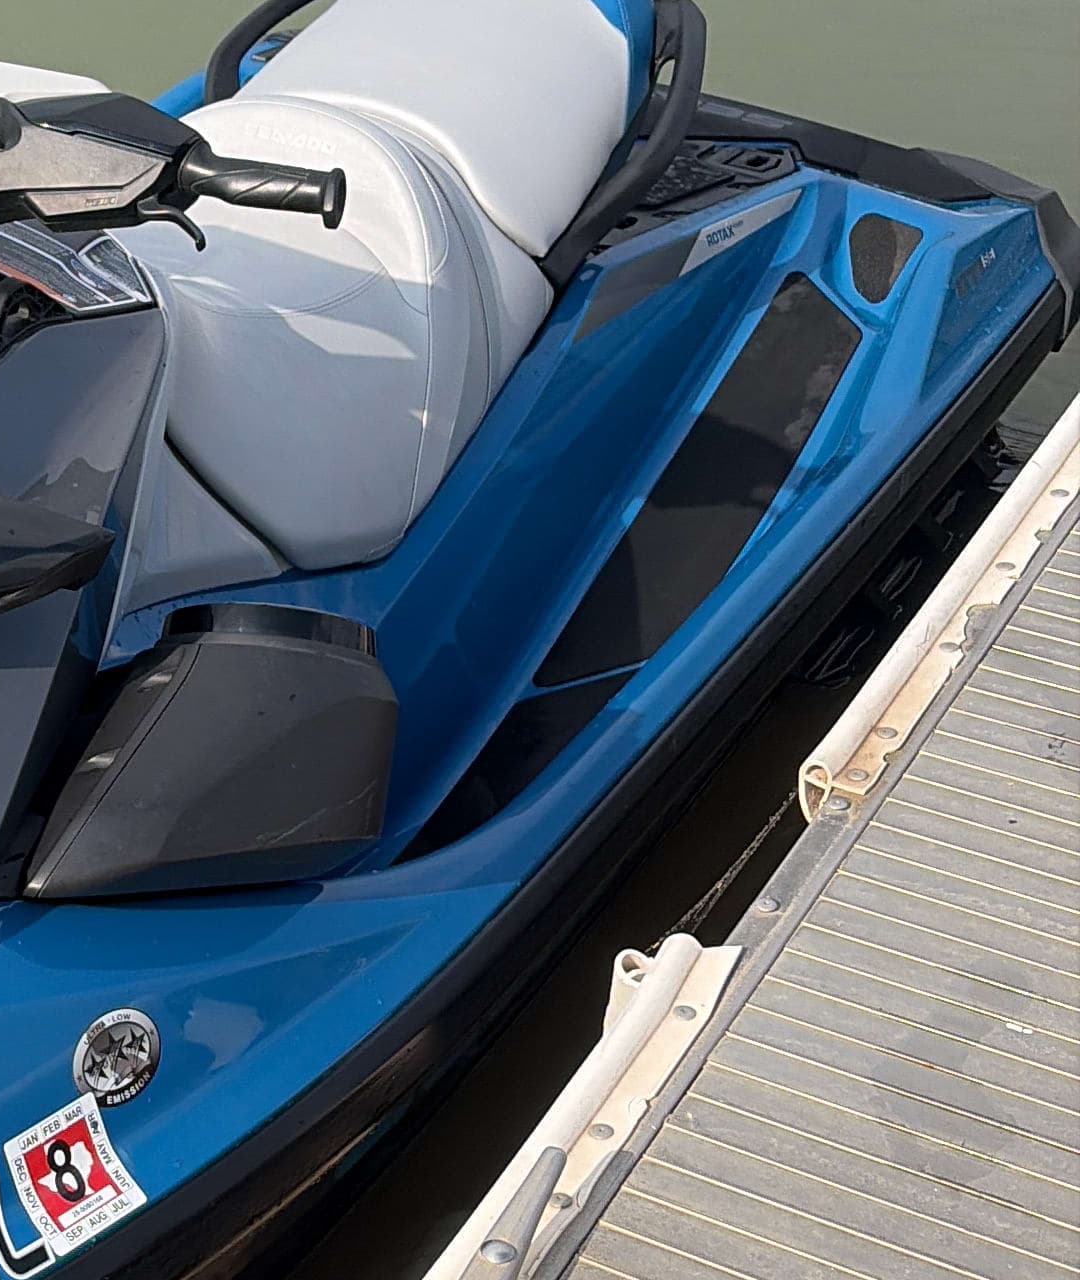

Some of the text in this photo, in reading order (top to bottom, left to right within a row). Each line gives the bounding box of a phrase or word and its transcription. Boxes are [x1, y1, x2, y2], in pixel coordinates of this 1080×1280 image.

[705, 224, 735, 247] ROTAX
[84, 1013, 131, 1045] ULTRA LOW
[106, 1071, 151, 1105] EMISSION
[20, 1106, 82, 1150] JAN FEB MAR
[47, 1139, 86, 1202] 8
[97, 1142, 113, 1165] MAY
[112, 1168, 131, 1189] JUN
[14, 1157, 58, 1236] DEC NOV OCT
[65, 1198, 129, 1242] SEP AUG JUL
